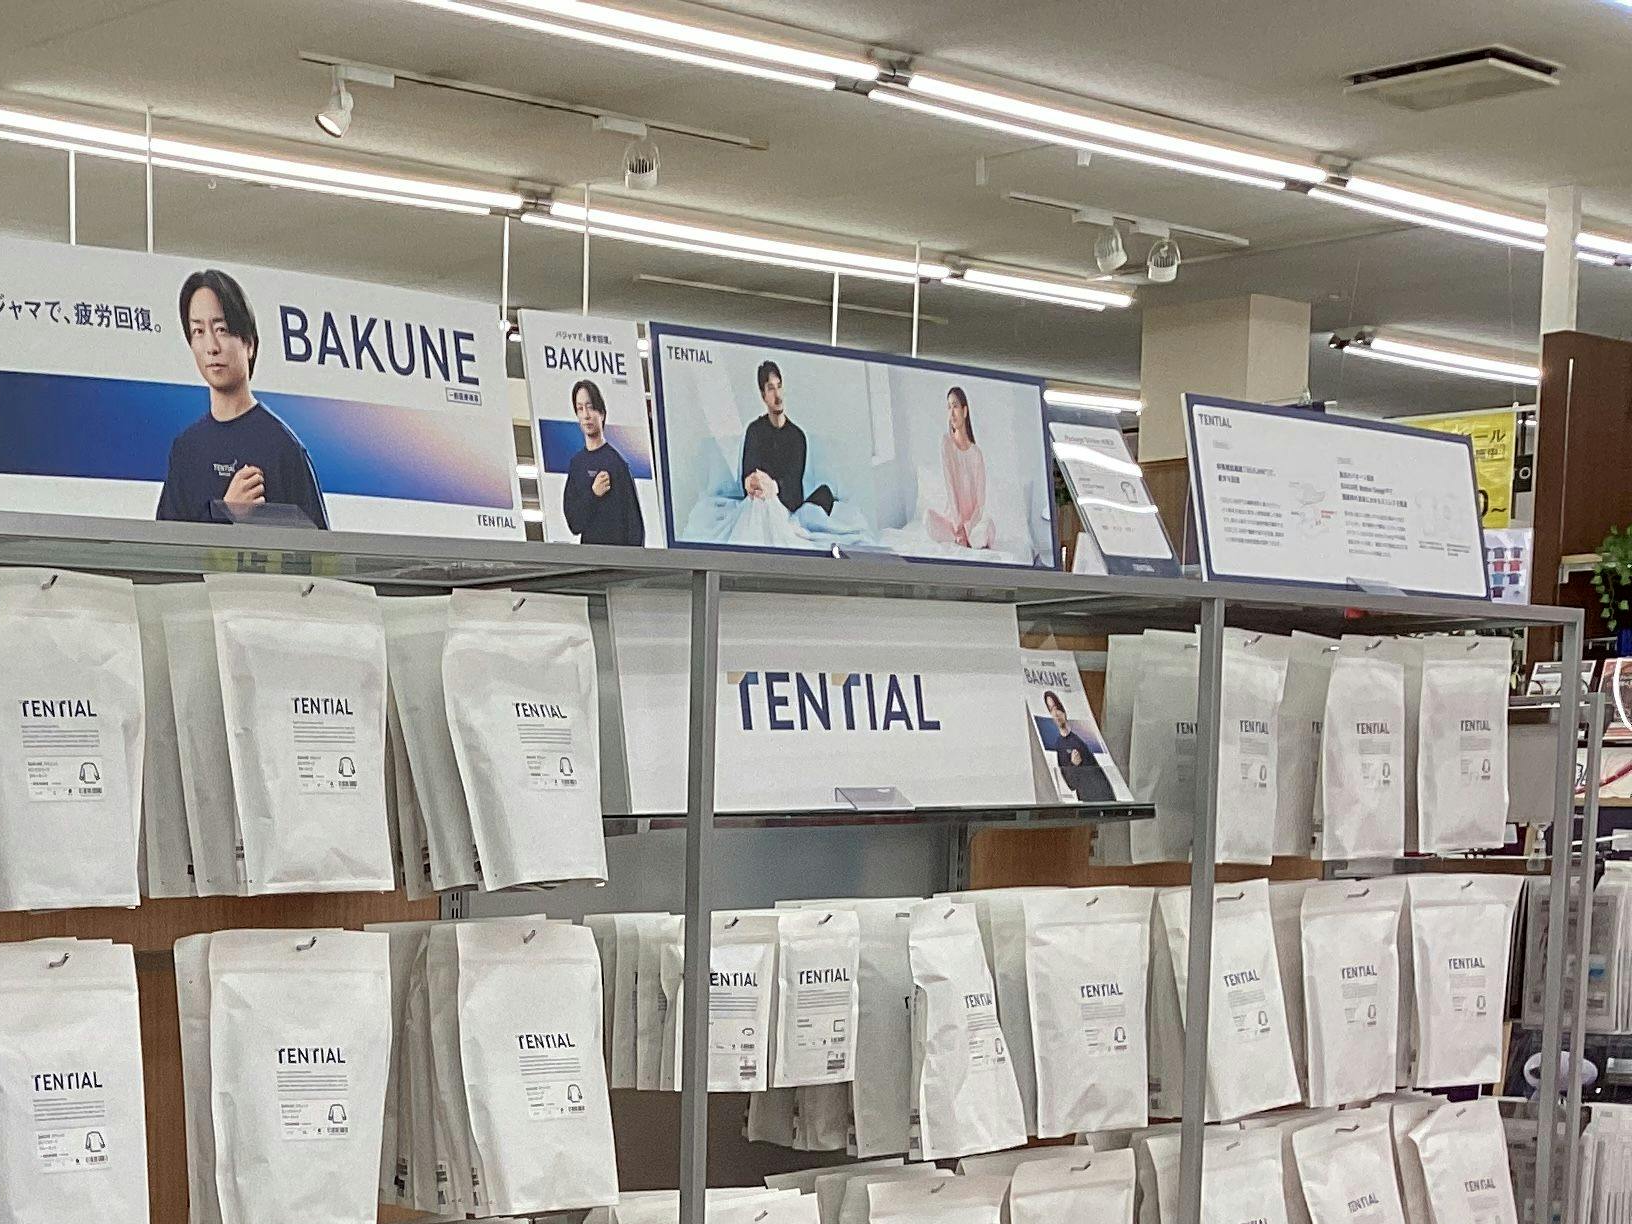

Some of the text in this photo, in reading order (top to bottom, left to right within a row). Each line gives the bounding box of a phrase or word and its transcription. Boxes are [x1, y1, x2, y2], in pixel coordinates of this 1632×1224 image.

[280, 305, 480, 385] BAKUNE
[545, 346, 626, 375] BAKUNE
[667, 346, 712, 364] TENTIAL
[1198, 413, 1232, 428] TENTIAL
[477, 514, 516, 528] TENTIAL
[1024, 668, 1071, 687] BAKUNE
[19, 700, 97, 717] TENTIAL
[293, 698, 353, 715] TENTIAL
[727, 671, 941, 731] TENTIAL
[515, 703, 567, 718] TENTIAL
[1356, 723, 1389, 734] TENTIAL
[1460, 720, 1491, 731] TENTIAL
[1448, 958, 1485, 969] TENTIAL
[799, 968, 849, 984] TENTIAL
[1223, 970, 1260, 987] TENTIAL
[1341, 965, 1377, 979] TENTIAL
[710, 973, 757, 987] ENTIAL
[1080, 983, 1123, 998] TENTIAL
[964, 993, 992, 1008] TENTIA
[517, 1034, 575, 1049] TENTIAL
[278, 1048, 345, 1064] TENTIAL
[34, 1072, 102, 1091] TENTIAL
